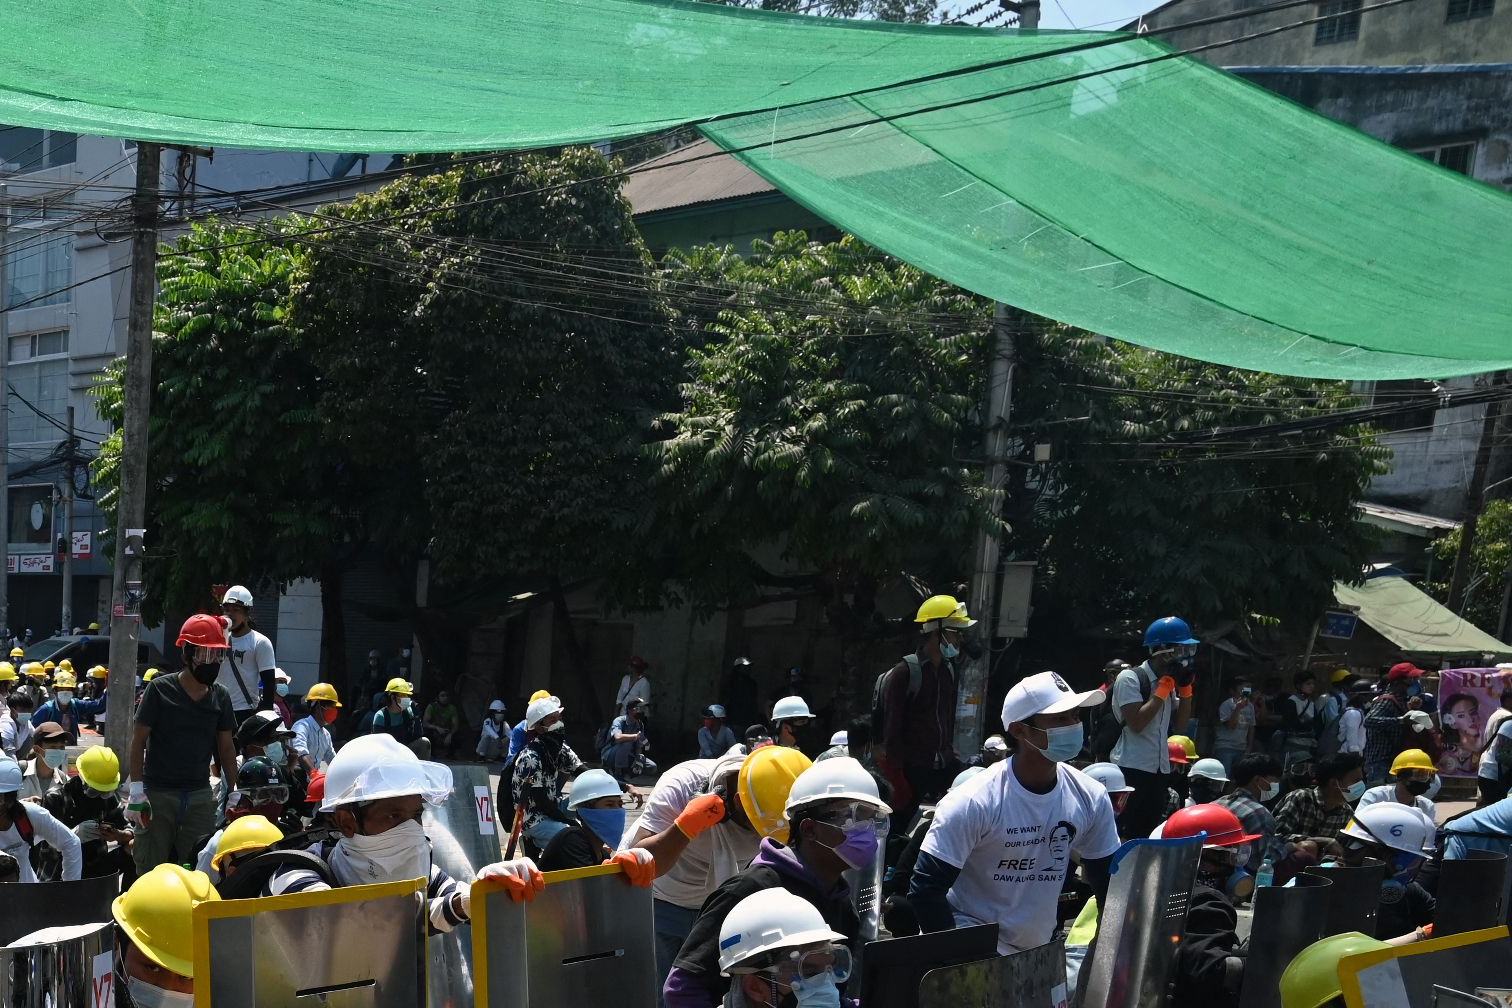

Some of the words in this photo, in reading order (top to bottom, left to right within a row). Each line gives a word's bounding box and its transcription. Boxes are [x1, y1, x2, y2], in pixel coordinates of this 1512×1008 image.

[475, 796, 493, 823] YZ
[1020, 825, 1042, 834] WANT
[998, 858, 1036, 871] FREE
[993, 873, 1014, 882] DAW
[1037, 874, 1056, 882] SAN
